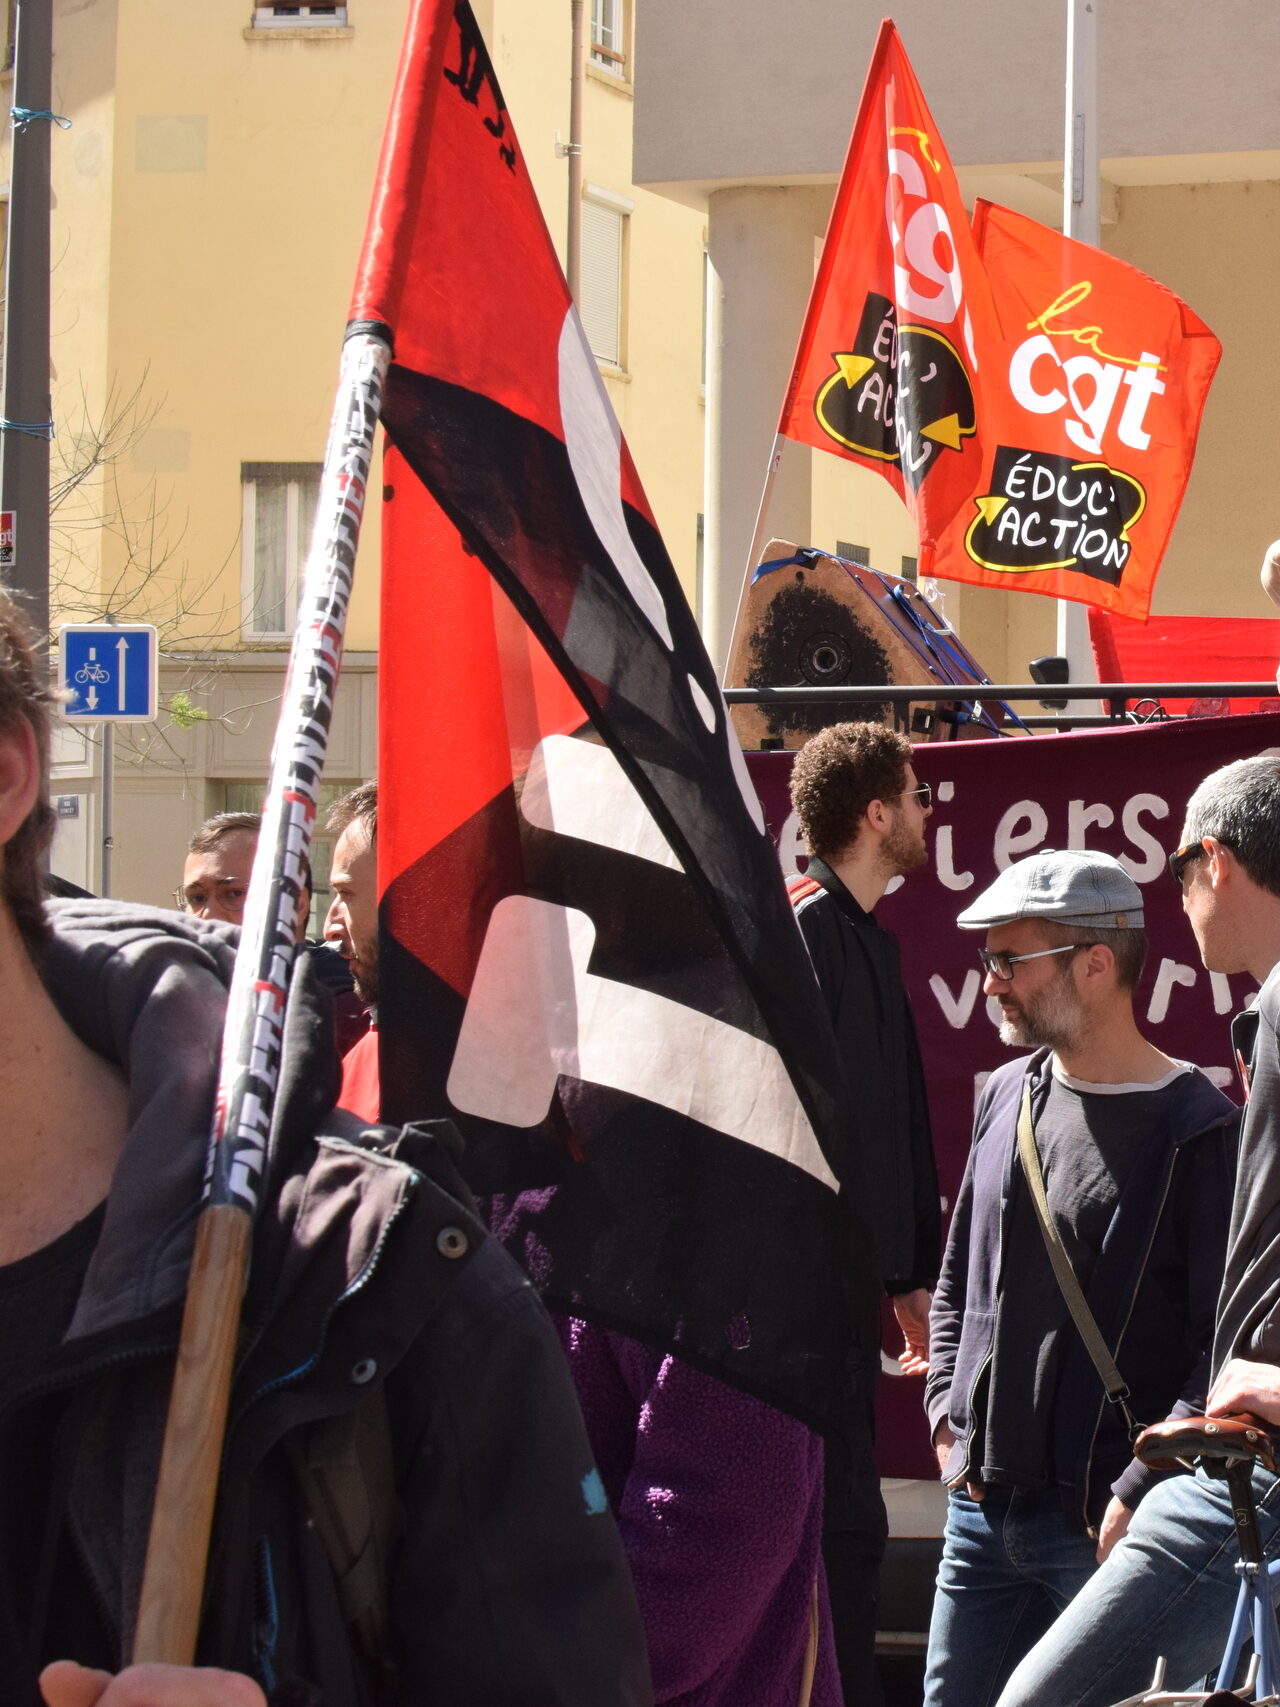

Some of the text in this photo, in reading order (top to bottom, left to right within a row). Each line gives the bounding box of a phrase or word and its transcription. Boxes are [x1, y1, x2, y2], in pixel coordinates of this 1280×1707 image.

[885, 148, 977, 373] cg
[1027, 281, 1168, 371] la
[1009, 334, 1166, 455] cgt
